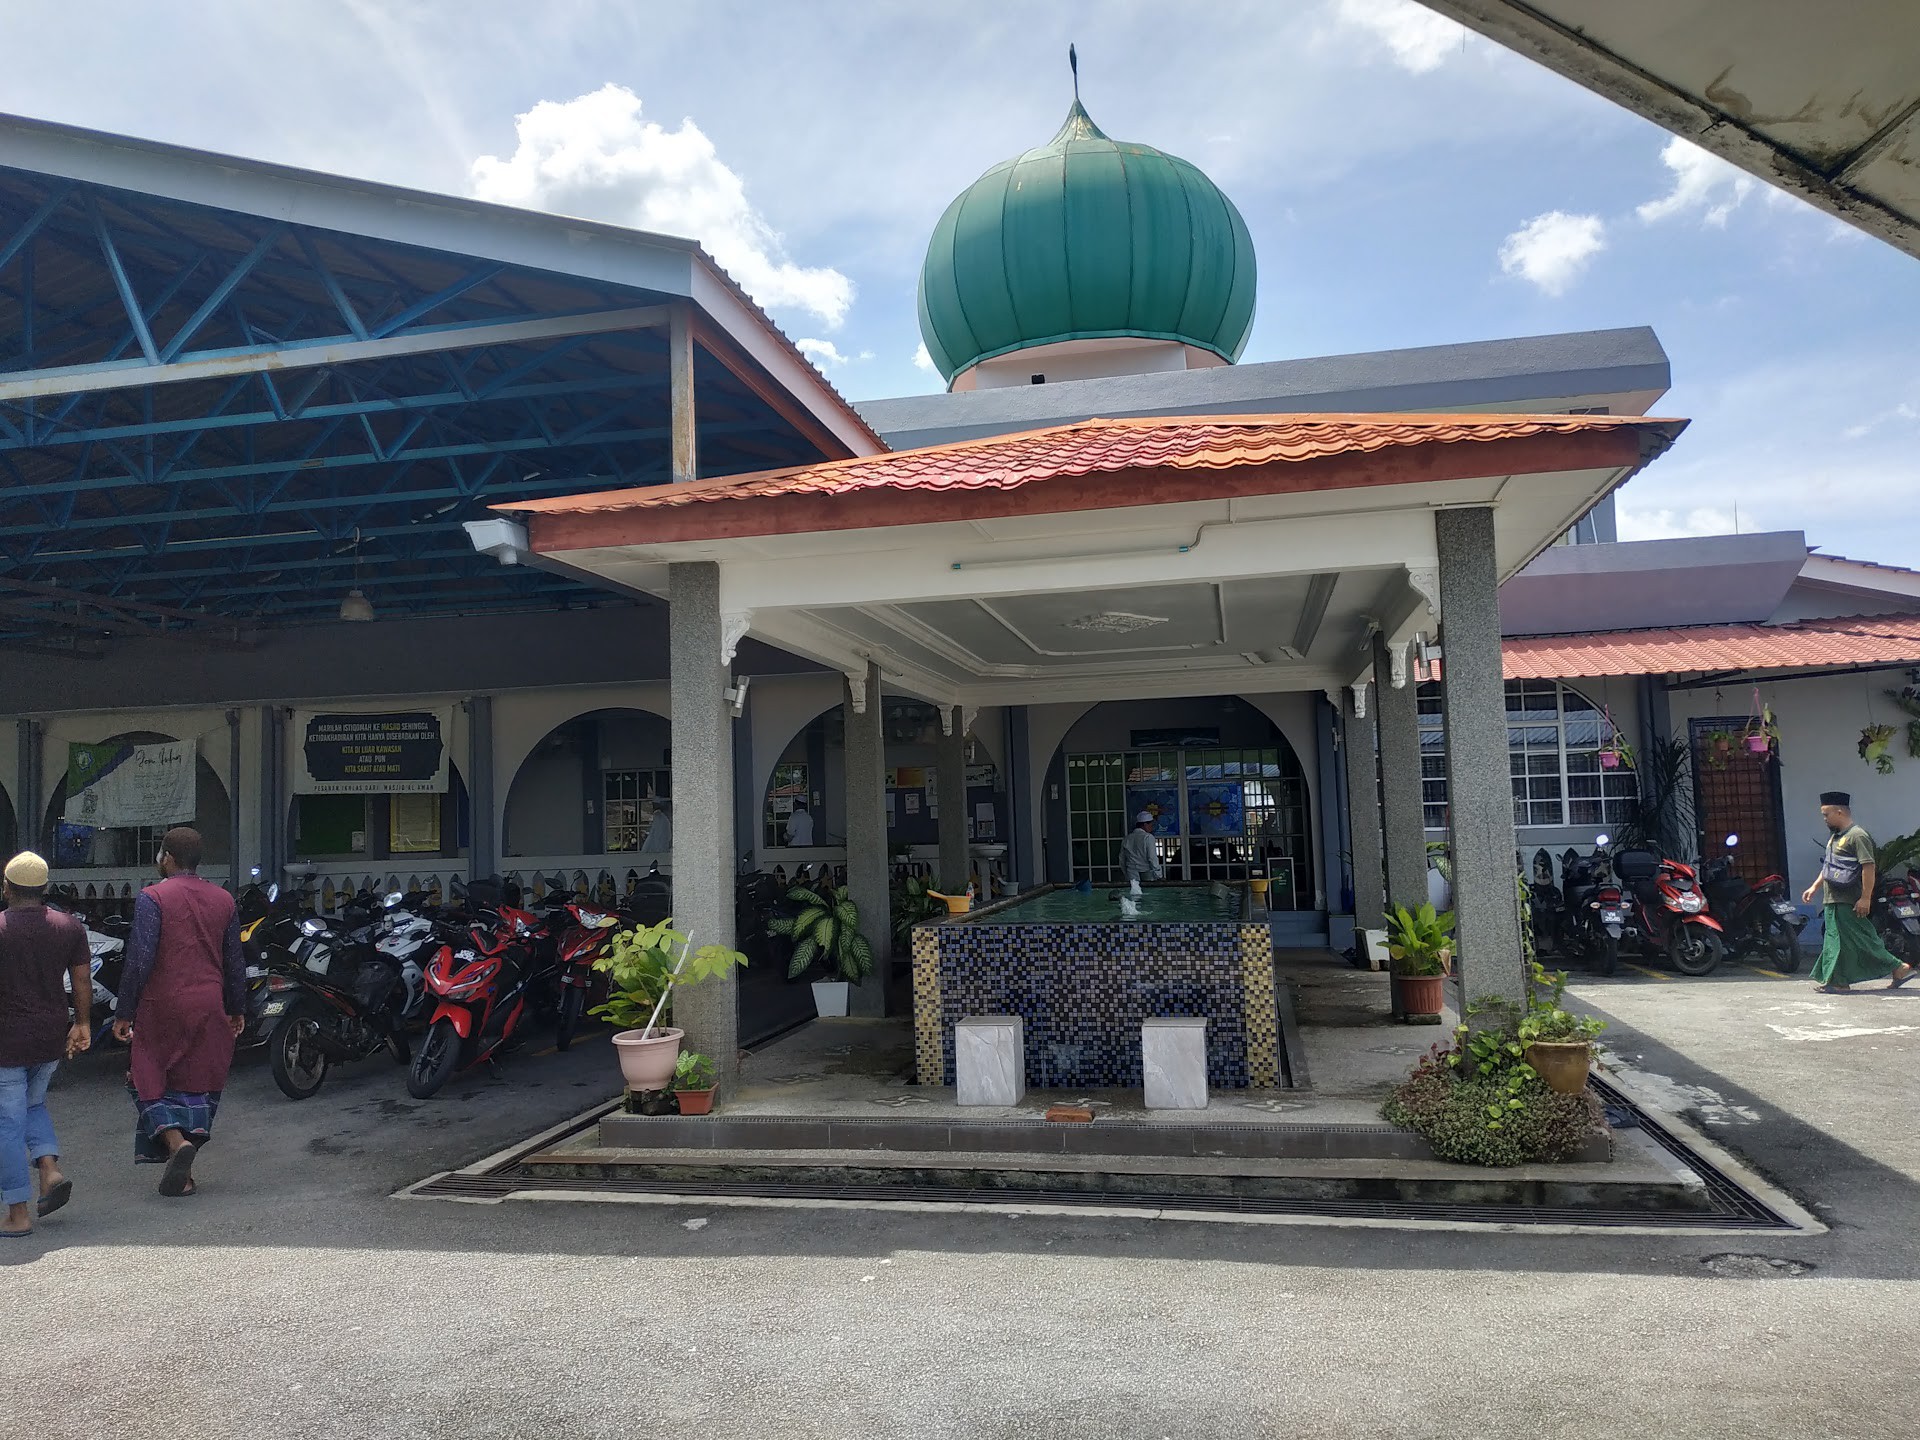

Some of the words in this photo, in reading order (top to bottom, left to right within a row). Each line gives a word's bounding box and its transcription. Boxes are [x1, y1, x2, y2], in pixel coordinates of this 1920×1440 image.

[373, 723, 381, 731] KE
[401, 722, 429, 730] SEHINGGA
[354, 733, 367, 741] KITA
[368, 732, 386, 741] HANYA
[420, 732, 435, 740] OLEH
[341, 745, 354, 754] KITA
[354, 745, 361, 754] DI
[361, 745, 376, 754] LUAR
[376, 745, 402, 754] KAWASAN
[358, 755, 373, 764] ATAU
[374, 755, 386, 764] PUN
[344, 765, 357, 773] KITA
[357, 764, 373, 773] SAKIT
[373, 764, 387, 773] ATAU
[387, 764, 401, 773] MATI
